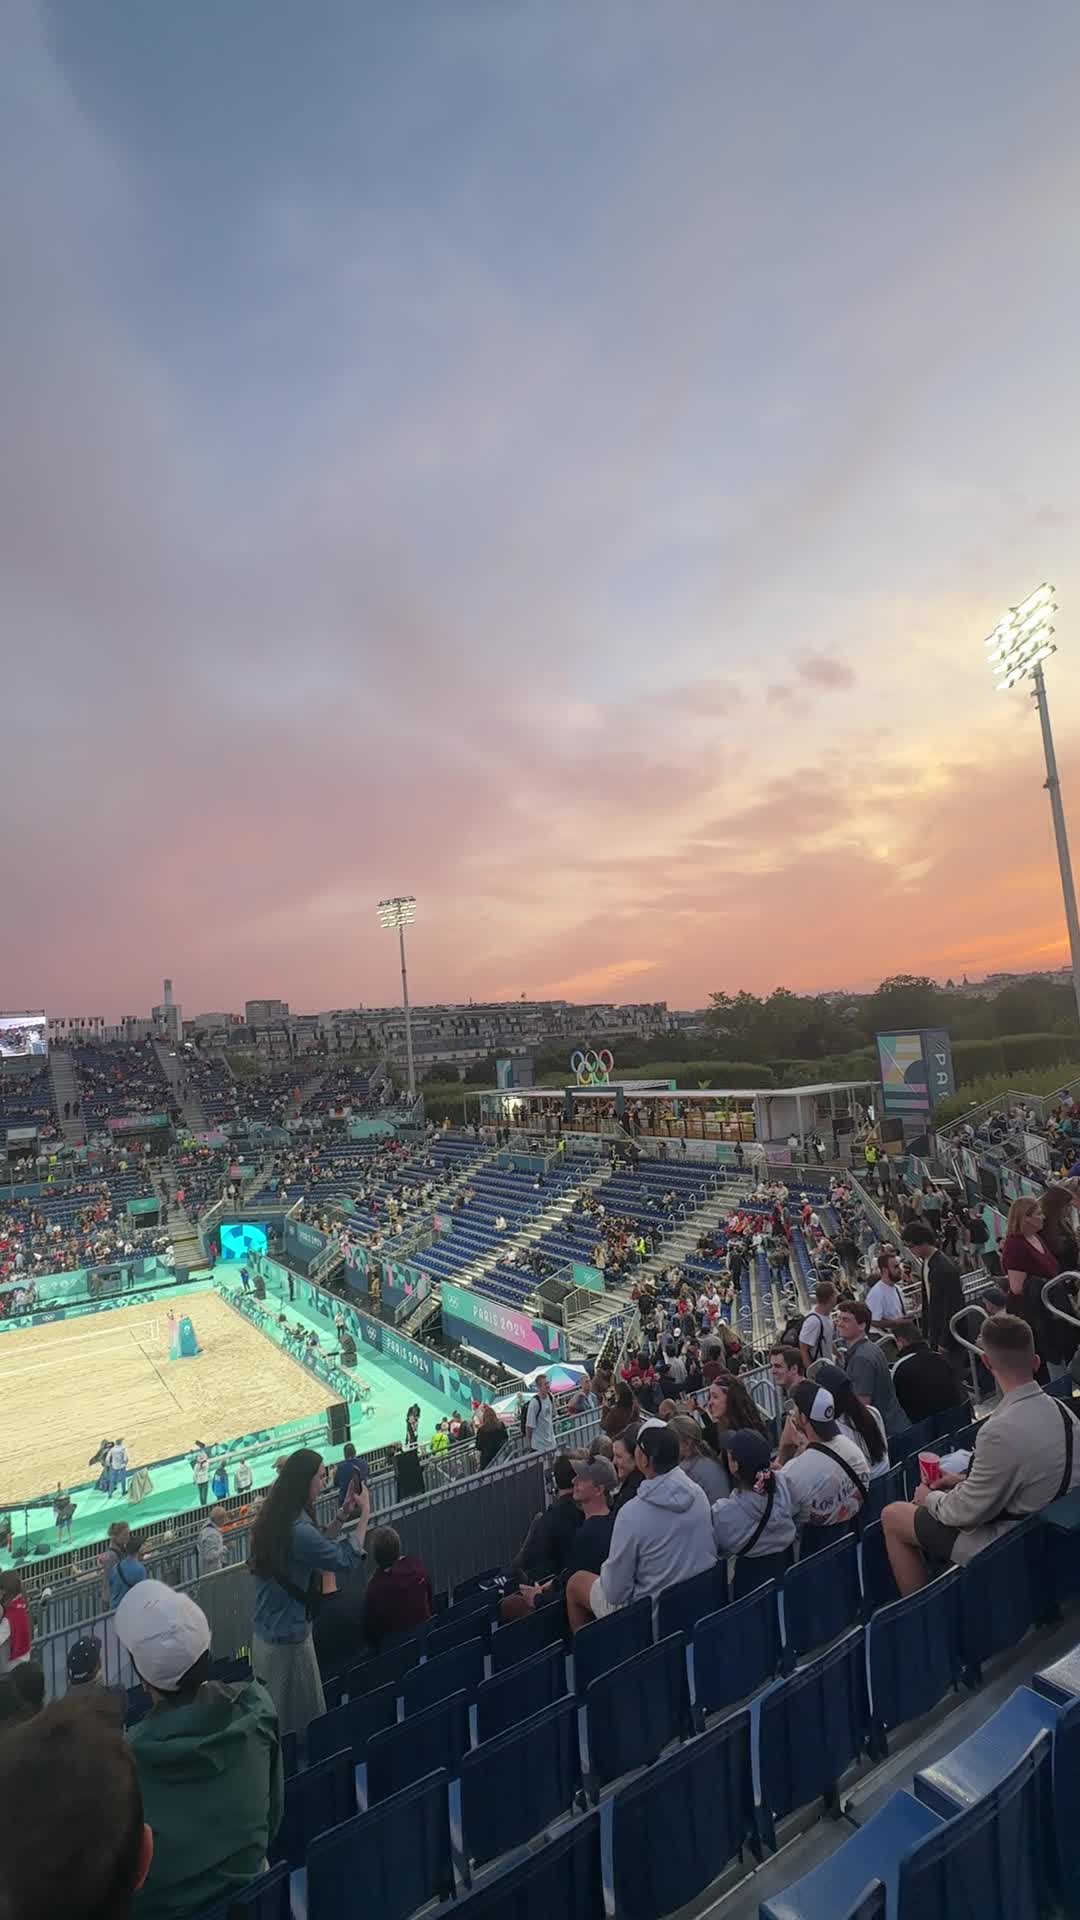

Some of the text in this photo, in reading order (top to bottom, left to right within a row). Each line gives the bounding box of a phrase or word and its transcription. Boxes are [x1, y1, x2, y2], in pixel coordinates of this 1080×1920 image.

[472, 1304, 526, 1340] PARIS 2024
[386, 1337, 429, 1374] PARIS 2024
